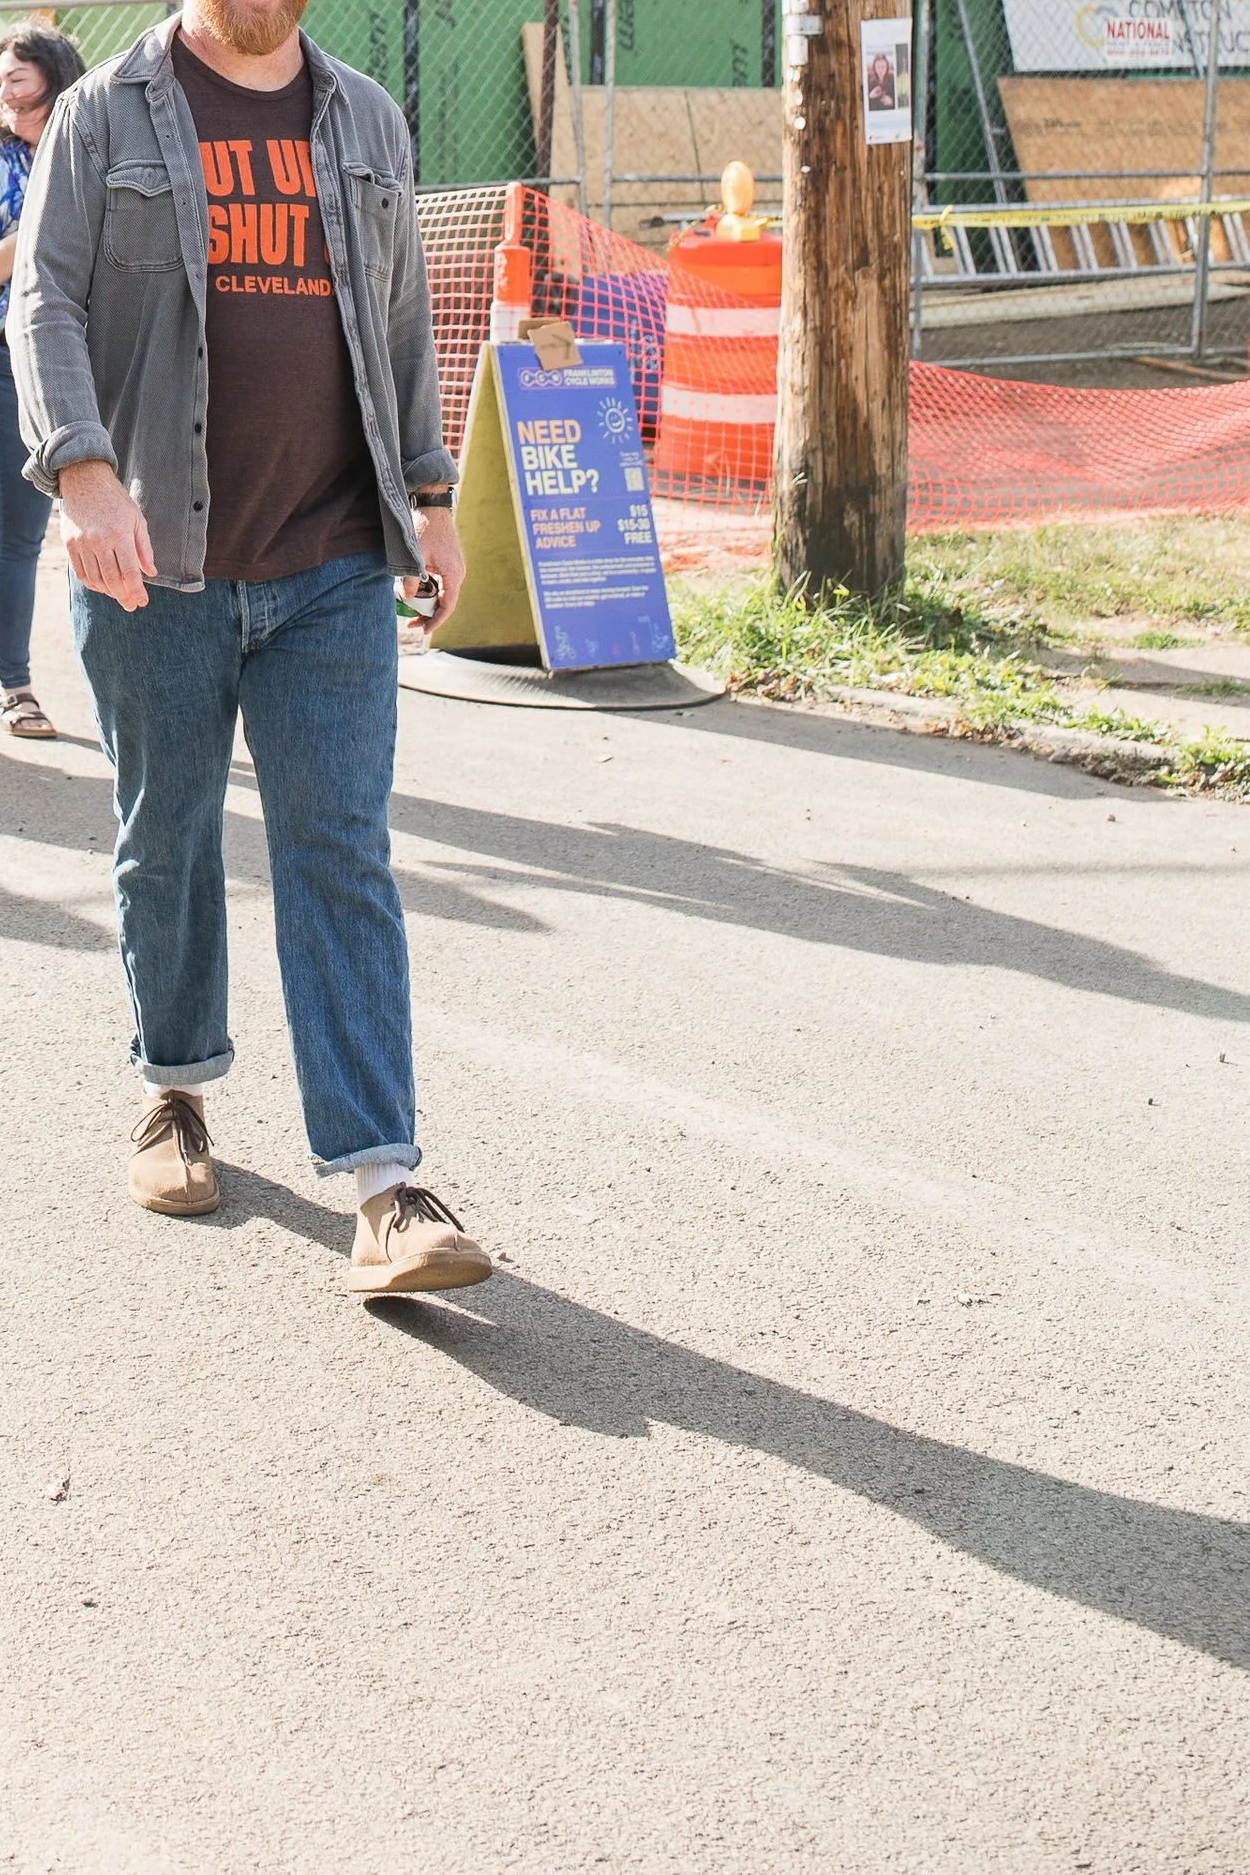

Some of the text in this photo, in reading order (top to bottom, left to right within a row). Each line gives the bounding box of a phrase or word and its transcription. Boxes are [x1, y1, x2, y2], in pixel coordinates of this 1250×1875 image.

[1106, 21, 1170, 39] NATIONAL
[199, 140, 255, 197] UT
[207, 203, 309, 267] SHUT
[517, 419, 582, 445] NEED
[521, 445, 578, 471] BIKE
[525, 469, 599, 496] HELP?
[530, 509, 548, 522] FIX
[559, 507, 586, 520] FLAT
[629, 504, 648, 517] $15
[532, 520, 601, 535] FRESHEN UP
[535, 535, 577, 549] ADVICE
[624, 531, 653, 545] FREE
